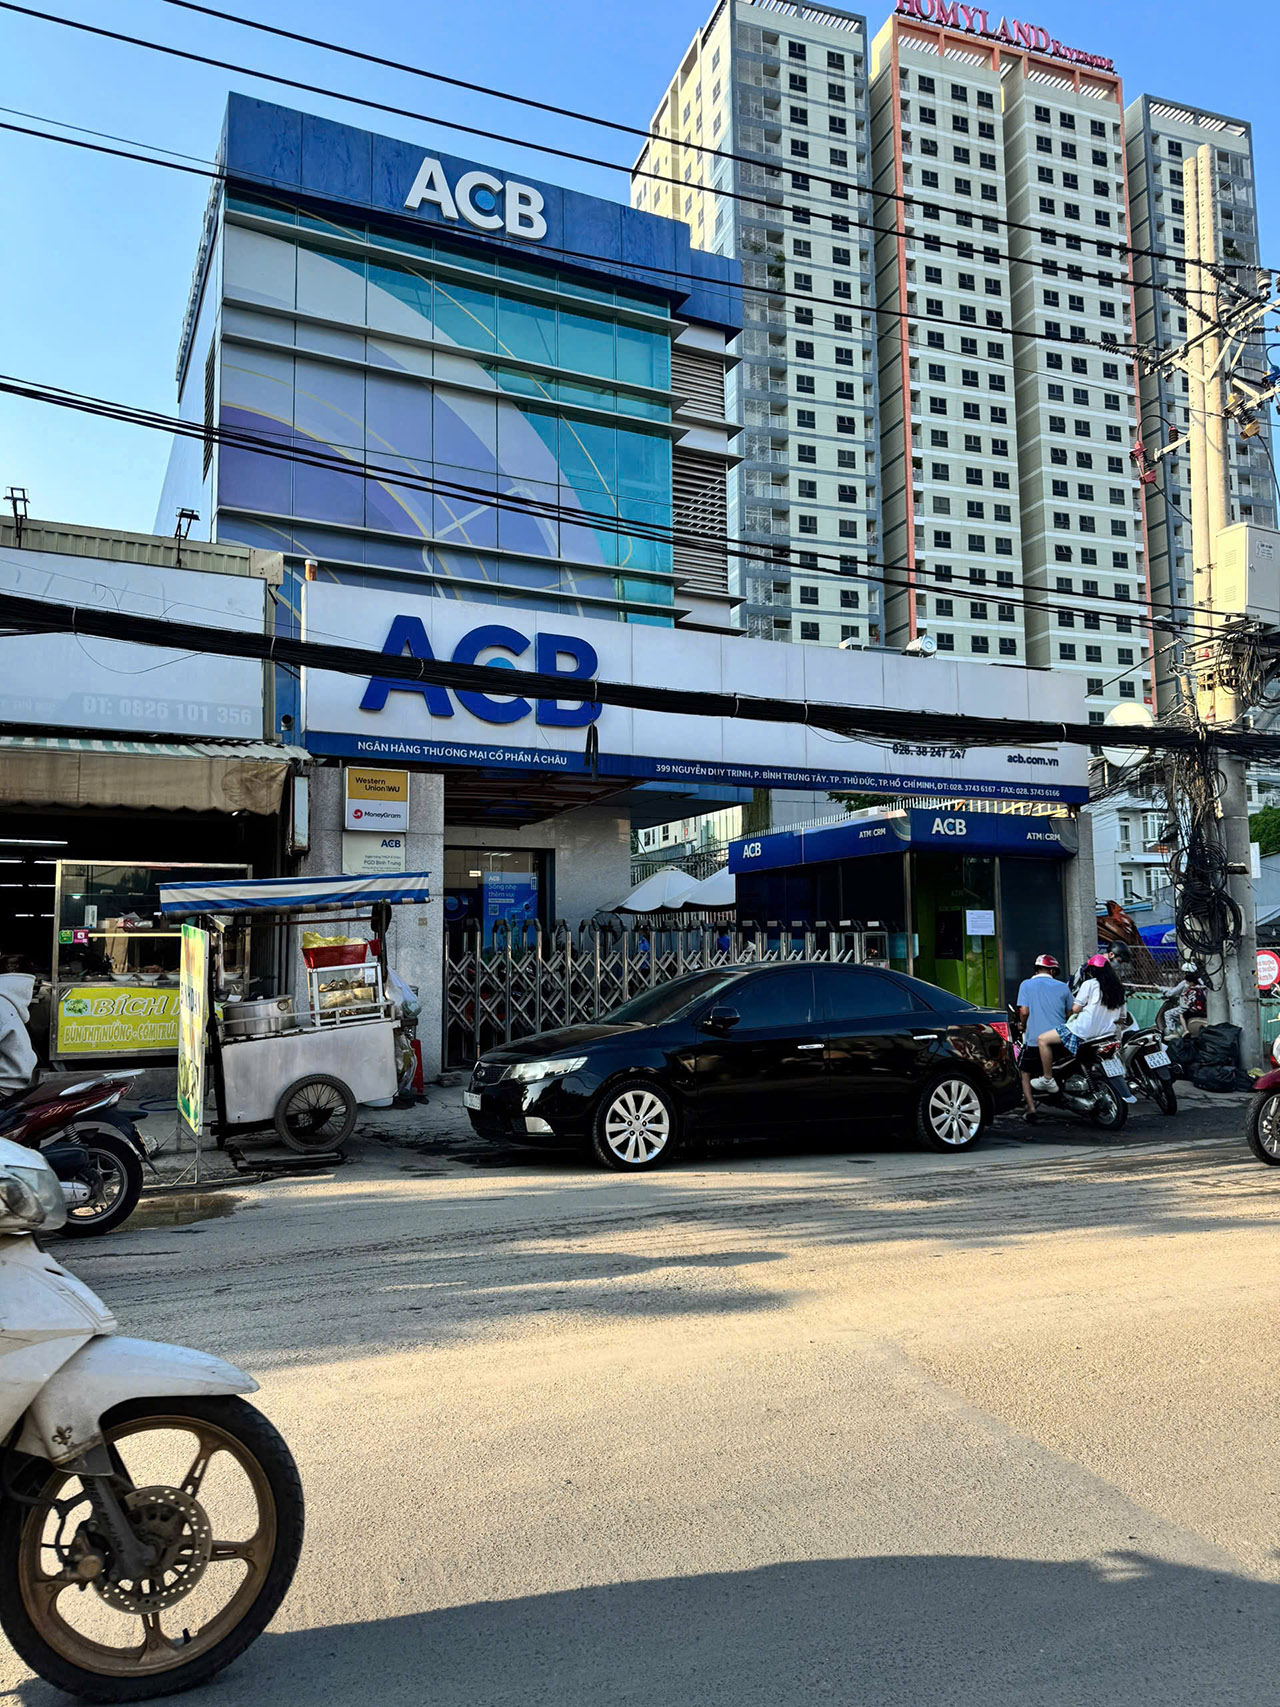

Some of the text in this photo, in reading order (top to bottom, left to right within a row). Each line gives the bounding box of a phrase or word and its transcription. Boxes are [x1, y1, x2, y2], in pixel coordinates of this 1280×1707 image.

[404, 156, 548, 241] ACB
[359, 614, 602, 728] ACB
[175, 703, 209, 722] 101
[217, 707, 252, 725] 356
[357, 741, 389, 752] NGÂN
[390, 742, 420, 754] HÀNG
[423, 746, 467, 758] THƯƠNG
[469, 750, 487, 761] MẠI
[533, 753, 540, 763] Á
[541, 755, 567, 765] CHÂU
[1007, 753, 1060, 767] acb.com.vn
[355, 777, 386, 785] Western
[656, 764, 671, 773] 399
[708, 768, 725, 776] DUY
[763, 770, 781, 779] BÌNH
[783, 773, 810, 782] TRƯNG
[830, 775, 841, 783] TP.
[878, 779, 889, 787] TP.
[903, 779, 915, 788] CHÍ
[917, 781, 937, 790] MINH,
[964, 784, 980, 792] 3743
[981, 785, 996, 793] 6167
[1001, 786, 1015, 794] FAX:
[1030, 788, 1045, 796] 3743
[1045, 789, 1060, 797] 6166
[364, 811, 401, 819] MoneyGram
[931, 817, 967, 836] ACB
[381, 839, 401, 848] ACB
[743, 842, 762, 859] ACB
[92, 993, 170, 1018] BÍCH
